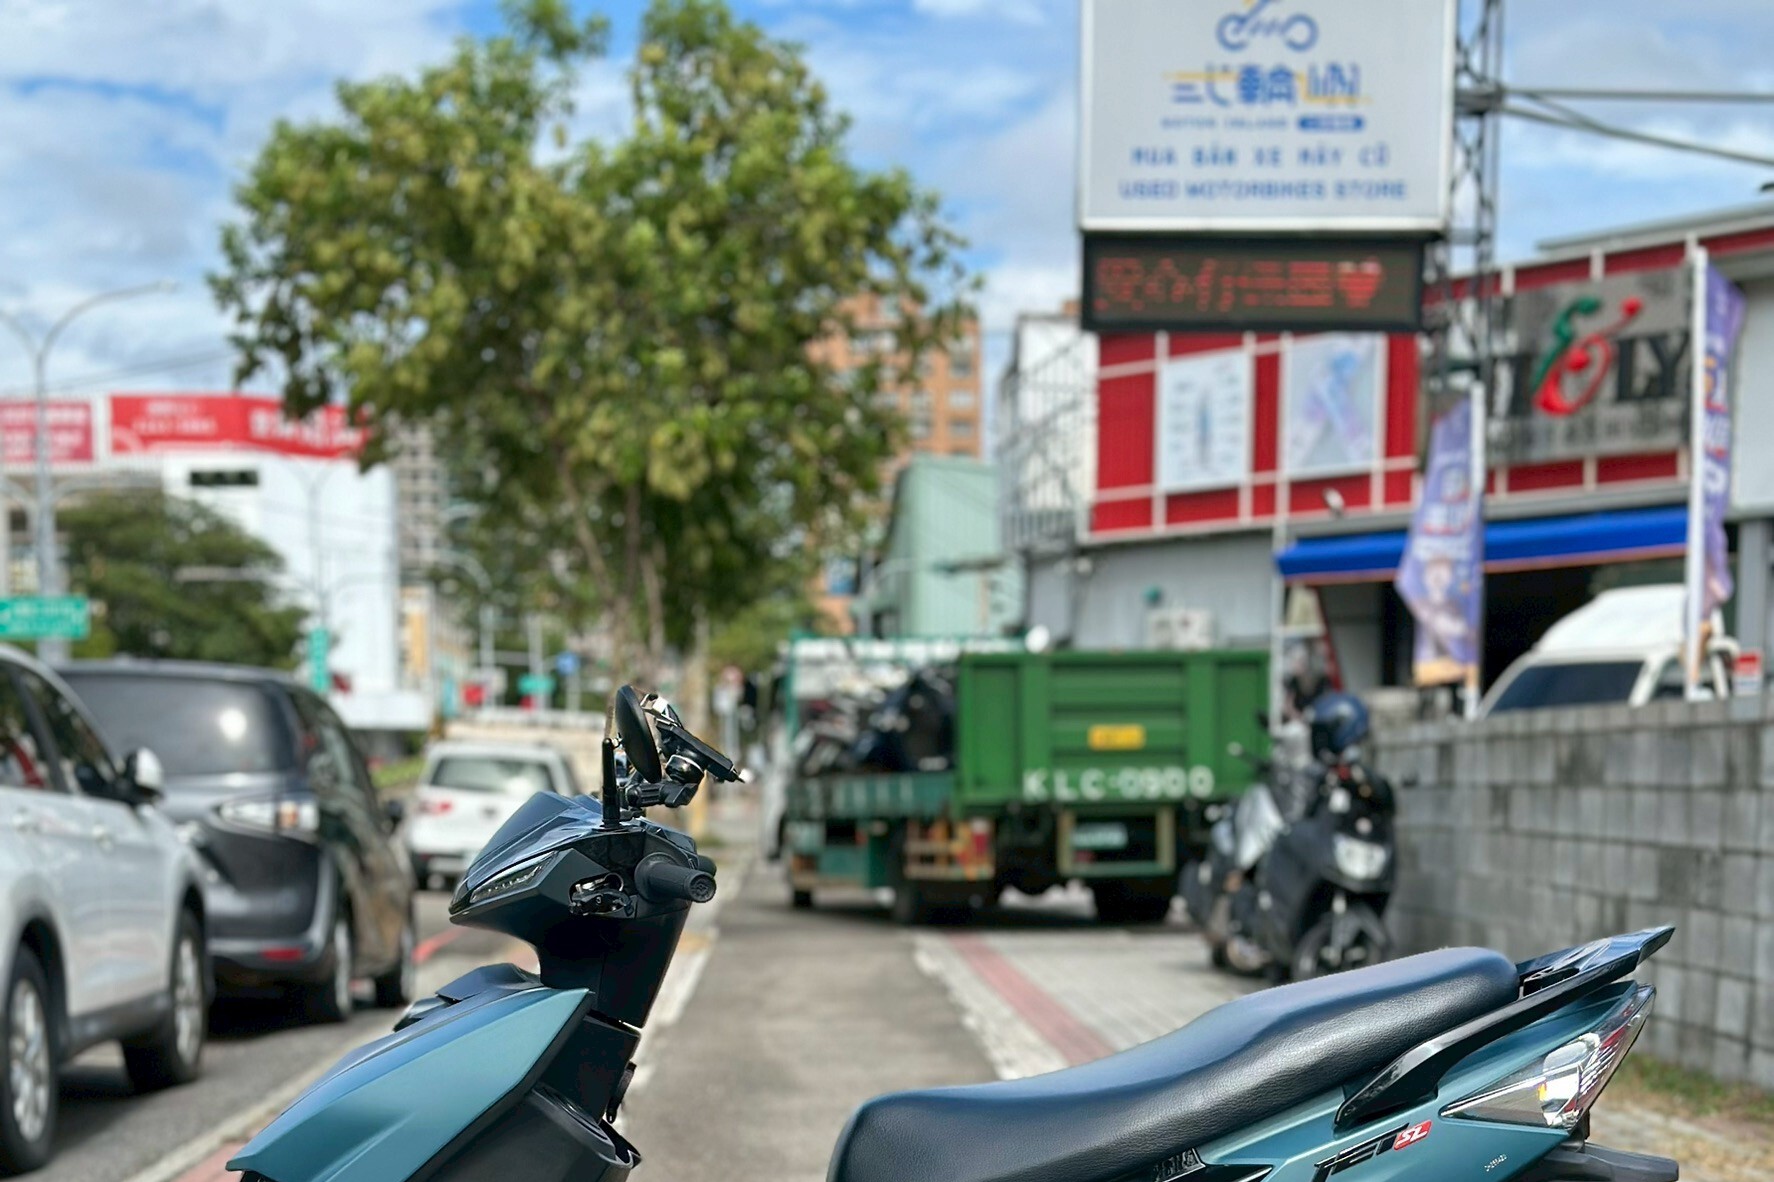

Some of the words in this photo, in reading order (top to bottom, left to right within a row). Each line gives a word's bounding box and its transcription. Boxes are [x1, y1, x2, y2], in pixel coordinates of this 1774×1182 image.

[1253, 146, 1282, 165] XE
[1119, 180, 1180, 200] USED
[1185, 179, 1327, 200] MOTORBIKES
[1335, 180, 1407, 200] STORE
